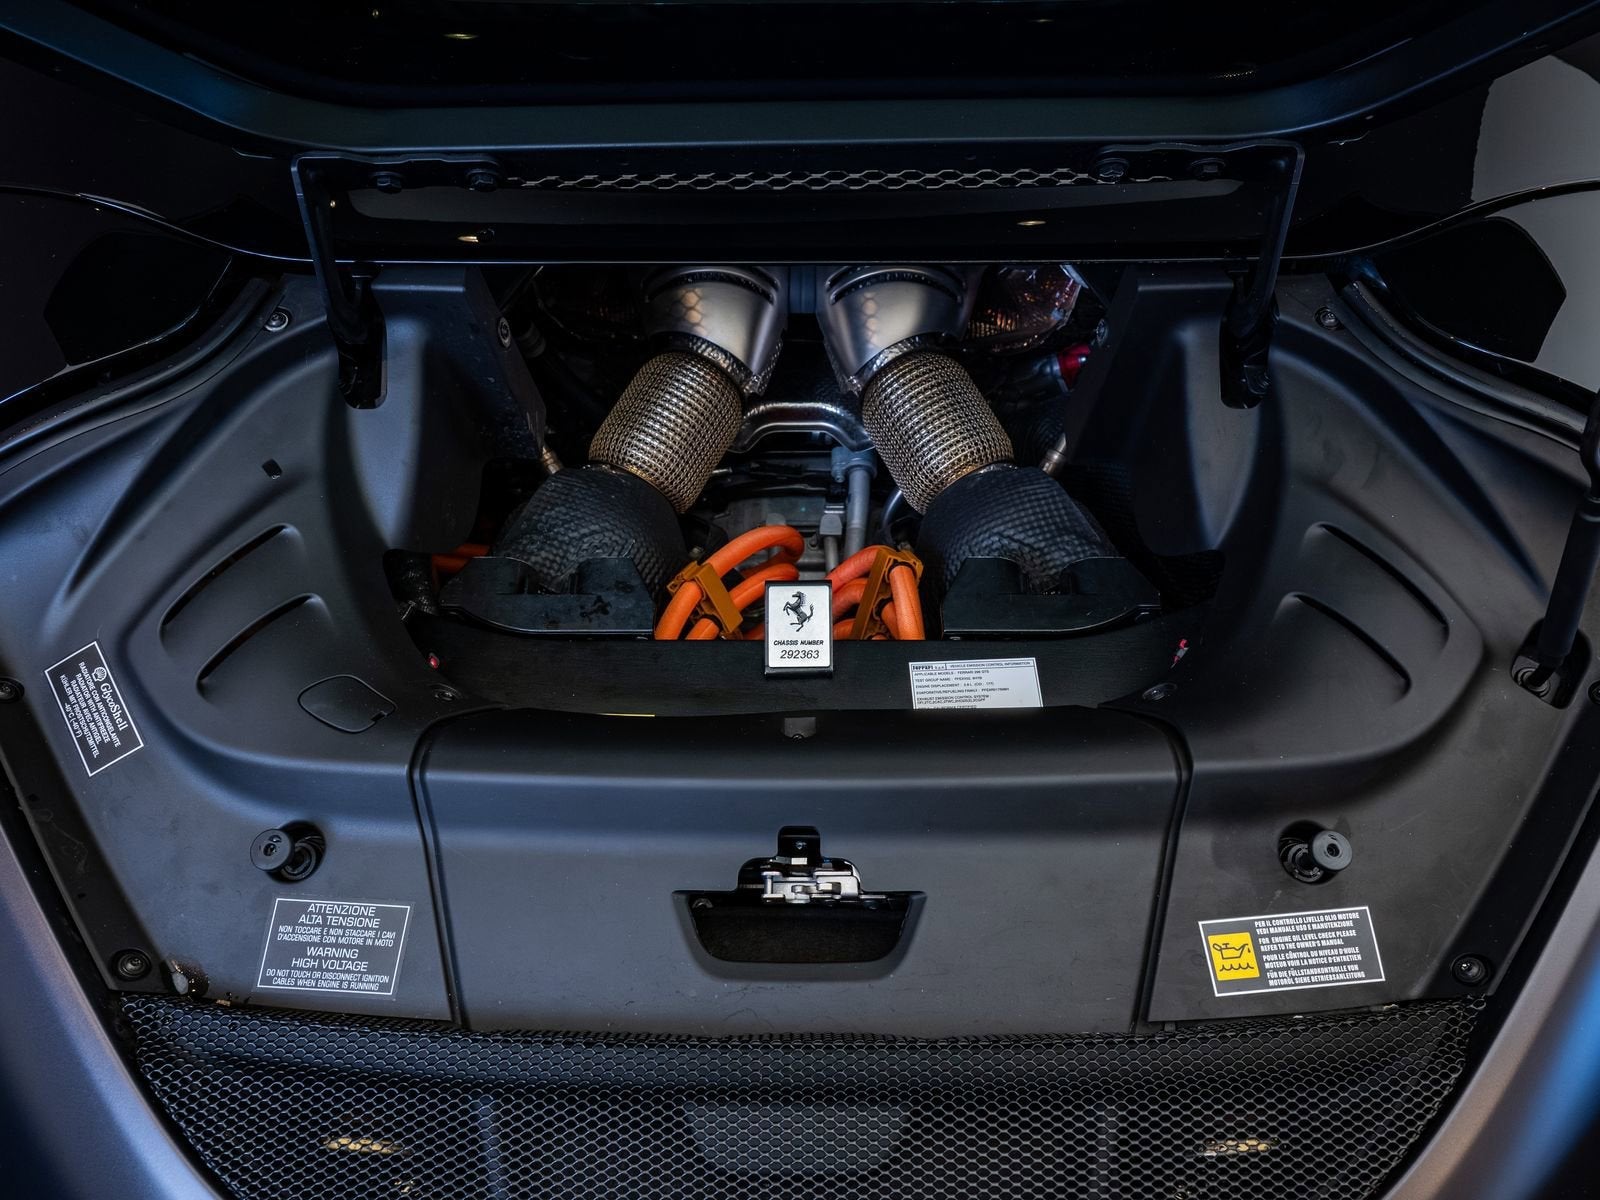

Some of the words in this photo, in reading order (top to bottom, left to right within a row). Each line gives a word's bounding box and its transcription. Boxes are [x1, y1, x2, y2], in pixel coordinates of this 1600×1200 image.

[780, 650, 819, 659] 292363
[68, 695, 77, 704] MIT
[79, 662, 95, 691] RADIATORE
[91, 690, 100, 702] CON
[97, 702, 121, 747] ANTICONGELANTE
[70, 680, 86, 708] RADIATEUR
[83, 708, 93, 722] AVEC
[88, 722, 102, 744] ANTIGEL
[76, 673, 91, 699] RADIATOR
[87, 698, 97, 712] WITH
[92, 712, 110, 743] ANTIFREEZE
[101, 683, 128, 731] GlycoShell
[72, 704, 100, 758] FROSTSCHUTZMITTEL
[307, 903, 376, 916] ATTENZIONE
[298, 915, 322, 924] ALTA
[326, 916, 380, 928] TENSIONE
[1272, 918, 1302, 926] CONTROLLO
[1312, 920, 1353, 930] MANUTENZIONE
[294, 926, 321, 935] TOCCARE
[345, 929, 376, 938] STACCARE
[277, 934, 321, 942] D'ACCENSIONE
[338, 937, 364, 945] MOTORE
[374, 938, 393, 947] MOTO
[306, 946, 359, 959] WARNING
[291, 958, 318, 968] HIGH
[322, 959, 368, 971] VOLTAGE
[290, 970, 310, 978] TOUCH
[322, 972, 361, 982] DISCONNECT
[362, 974, 389, 983] IGNITION
[1311, 971, 1365, 982] BETRIEBSANLEITUNG
[272, 977, 295, 986] CABLES
[318, 980, 340, 988] ENGINE
[350, 982, 379, 990] RUNNING
